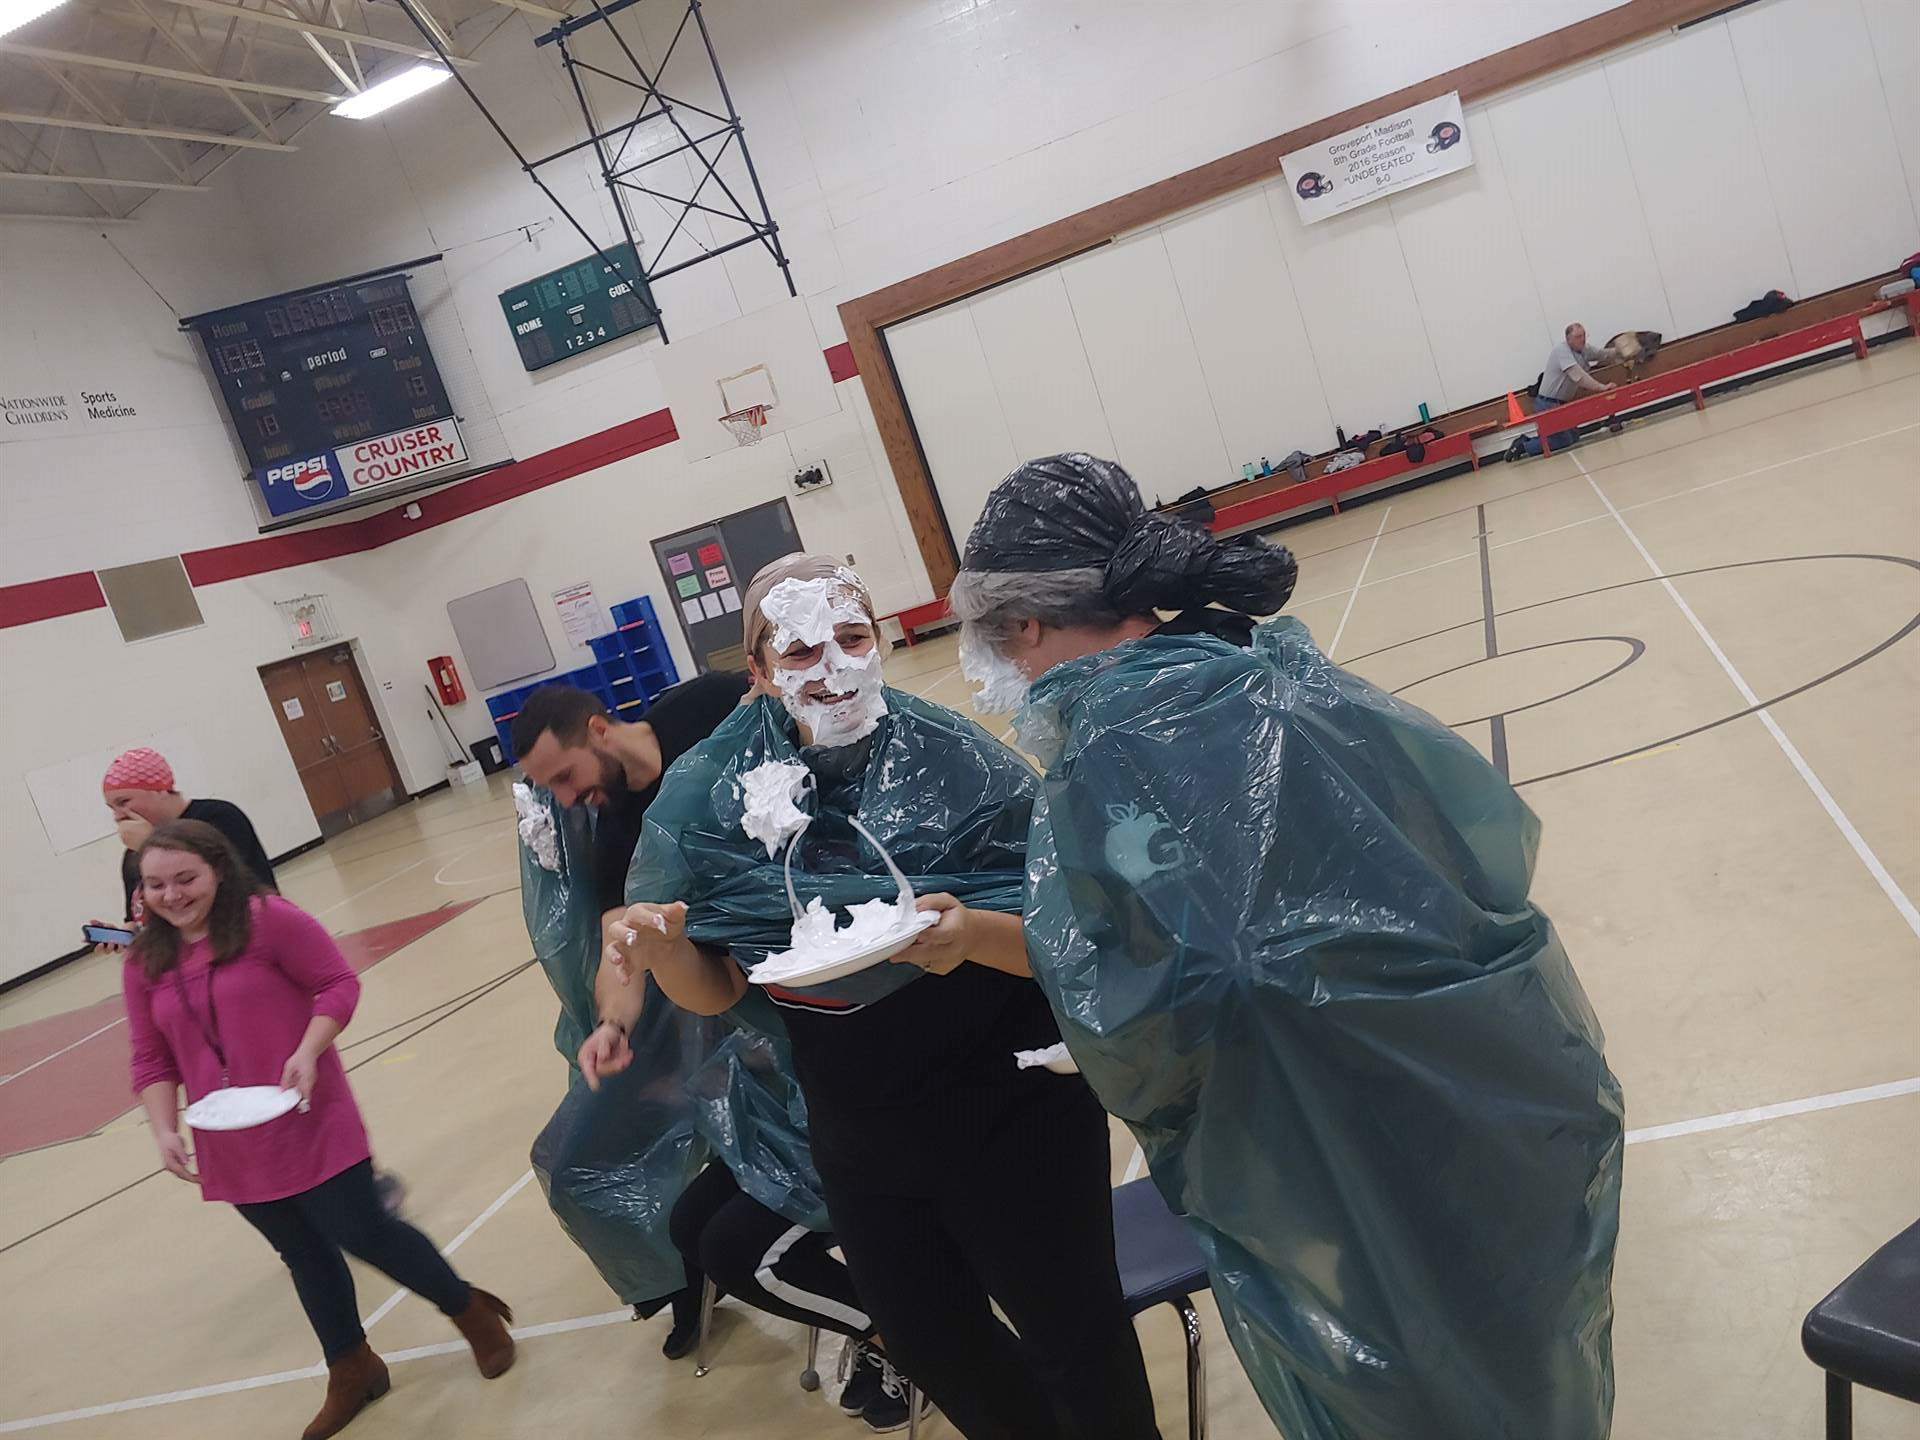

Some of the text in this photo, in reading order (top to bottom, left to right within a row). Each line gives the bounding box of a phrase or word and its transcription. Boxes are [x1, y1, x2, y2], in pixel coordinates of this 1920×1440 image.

[1329, 118, 1412, 155] Groveport Madison
[1333, 128, 1415, 166] 8th Grade Football
[1344, 152, 1415, 184] "UNDEFEATED"
[1348, 146, 1406, 173] 2016 Season
[1376, 173, 1391, 185] 8-0
[603, 262, 621, 273] BOUS
[516, 317, 543, 336] HOME
[566, 326, 606, 349] 1 2 3 4
[307, 347, 347, 370] period
[0, 395, 68, 410] NATIONWIDE
[80, 391, 117, 406] Sports
[88, 405, 136, 419] Medicine
[353, 426, 442, 464] CRUISER
[267, 455, 329, 486] PEPSI
[353, 443, 455, 486] COUNTRY
